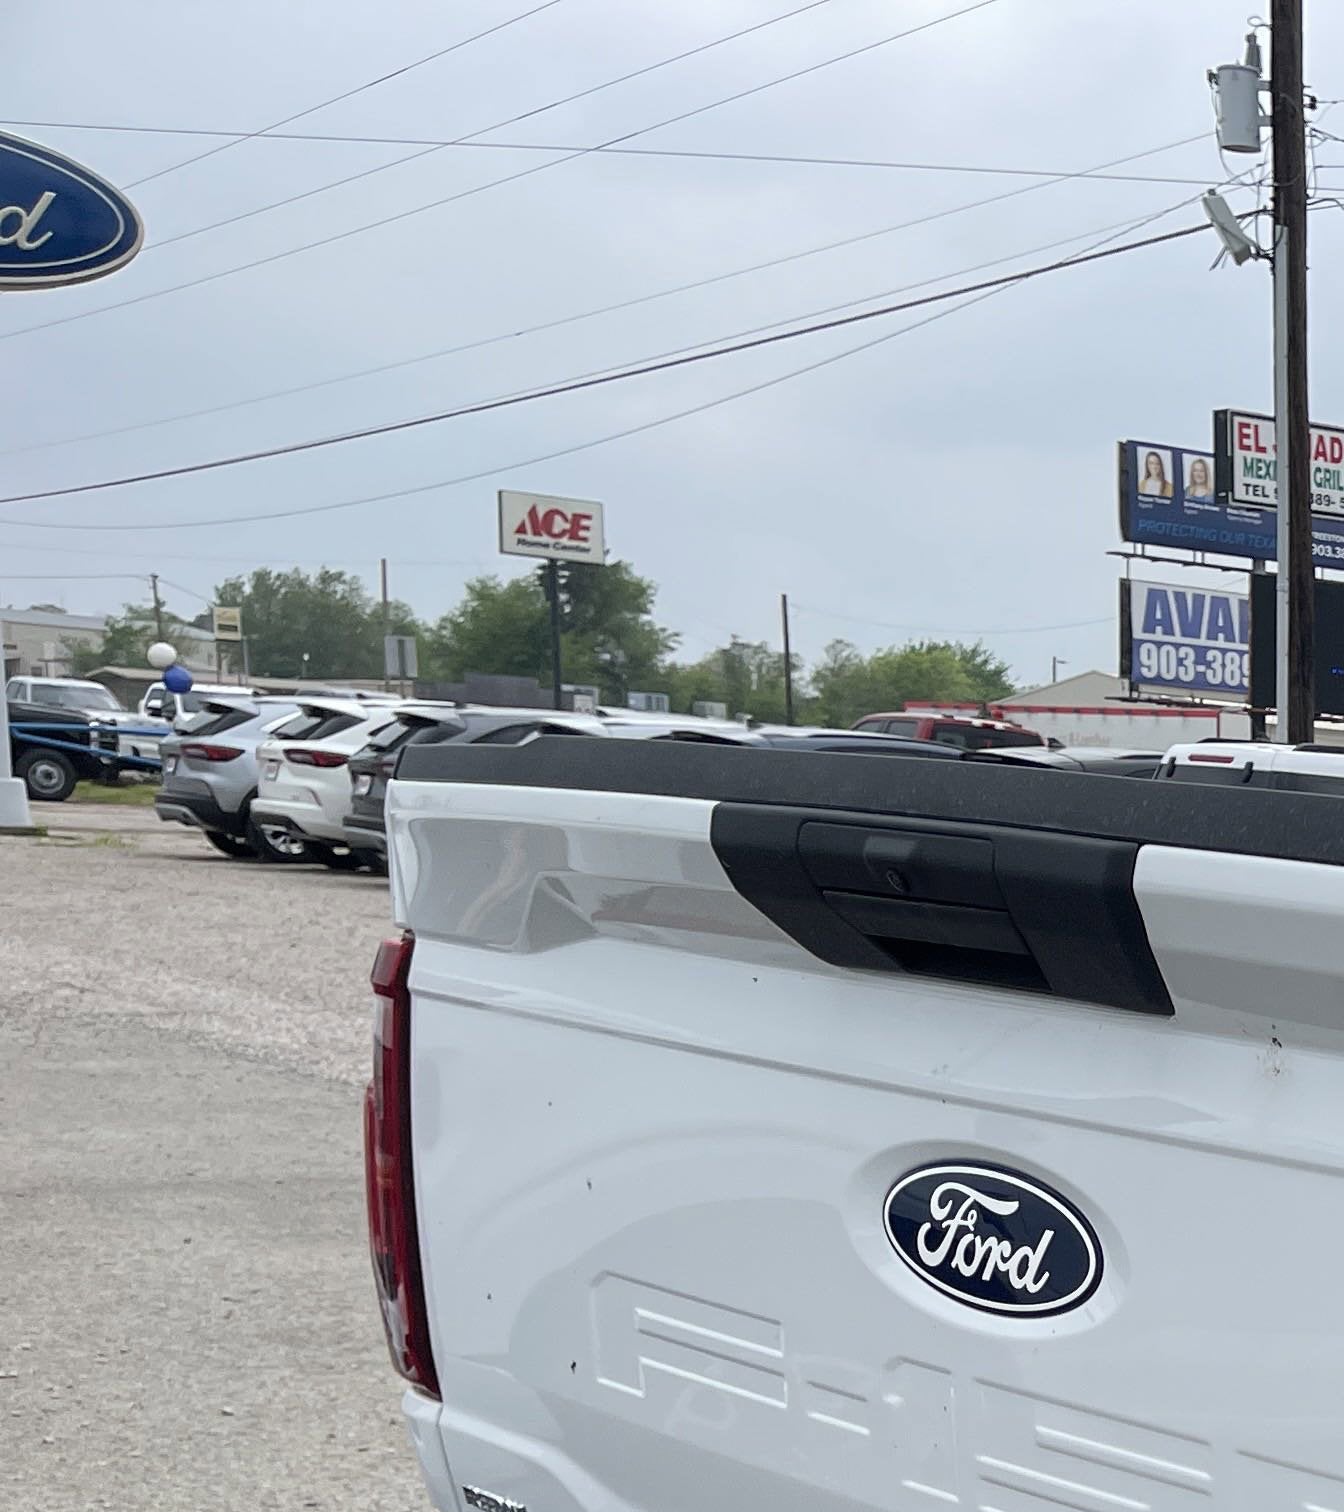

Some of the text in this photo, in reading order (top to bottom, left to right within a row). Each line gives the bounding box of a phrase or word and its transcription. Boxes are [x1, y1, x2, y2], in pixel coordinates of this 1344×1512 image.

[1237, 422, 1267, 454] EL
[1243, 456, 1278, 481] MEXI
[1243, 483, 1270, 498] TEL
[514, 503, 593, 543] ACE
[1137, 519, 1277, 548] PROTECTING OUR TEXA
[917, 1181, 1055, 1294] Ford
